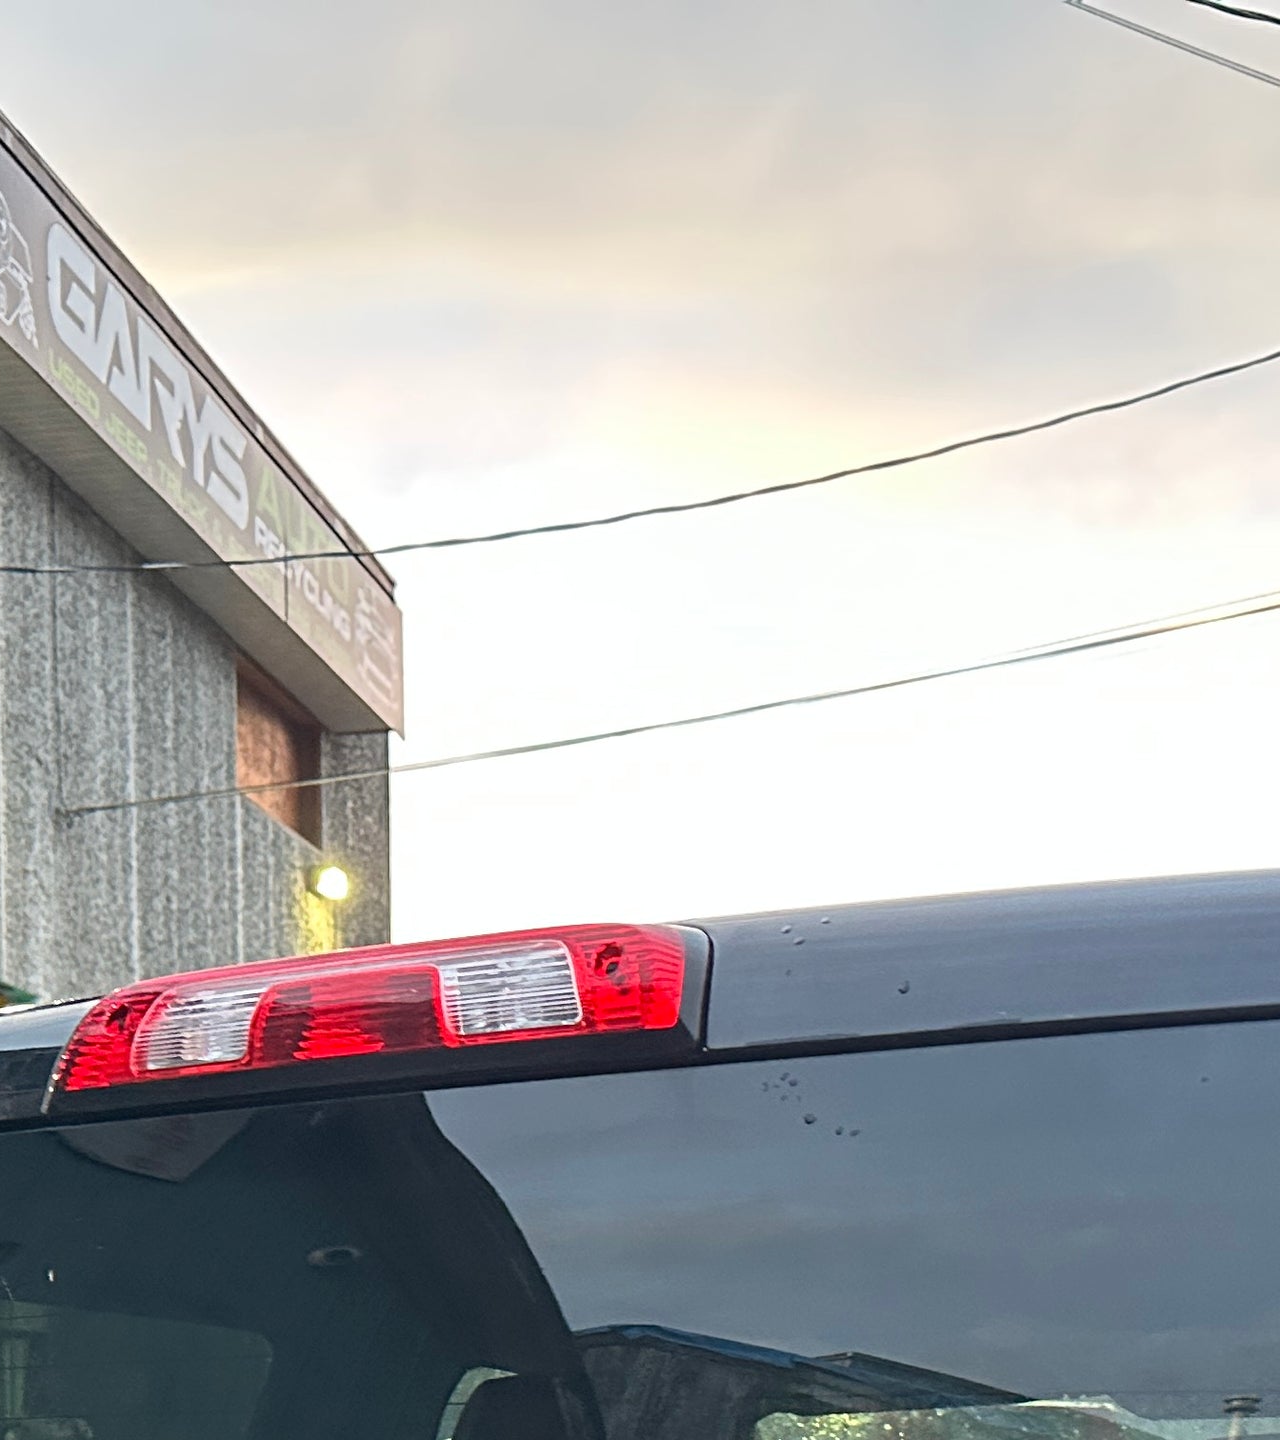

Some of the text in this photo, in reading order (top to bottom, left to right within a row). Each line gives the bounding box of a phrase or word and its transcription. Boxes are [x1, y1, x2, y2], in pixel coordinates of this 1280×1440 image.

[46, 222, 249, 530] GARYS
[48, 348, 100, 420] USED
[254, 515, 351, 642] RECYCLING
[256, 466, 350, 604] AUTO
